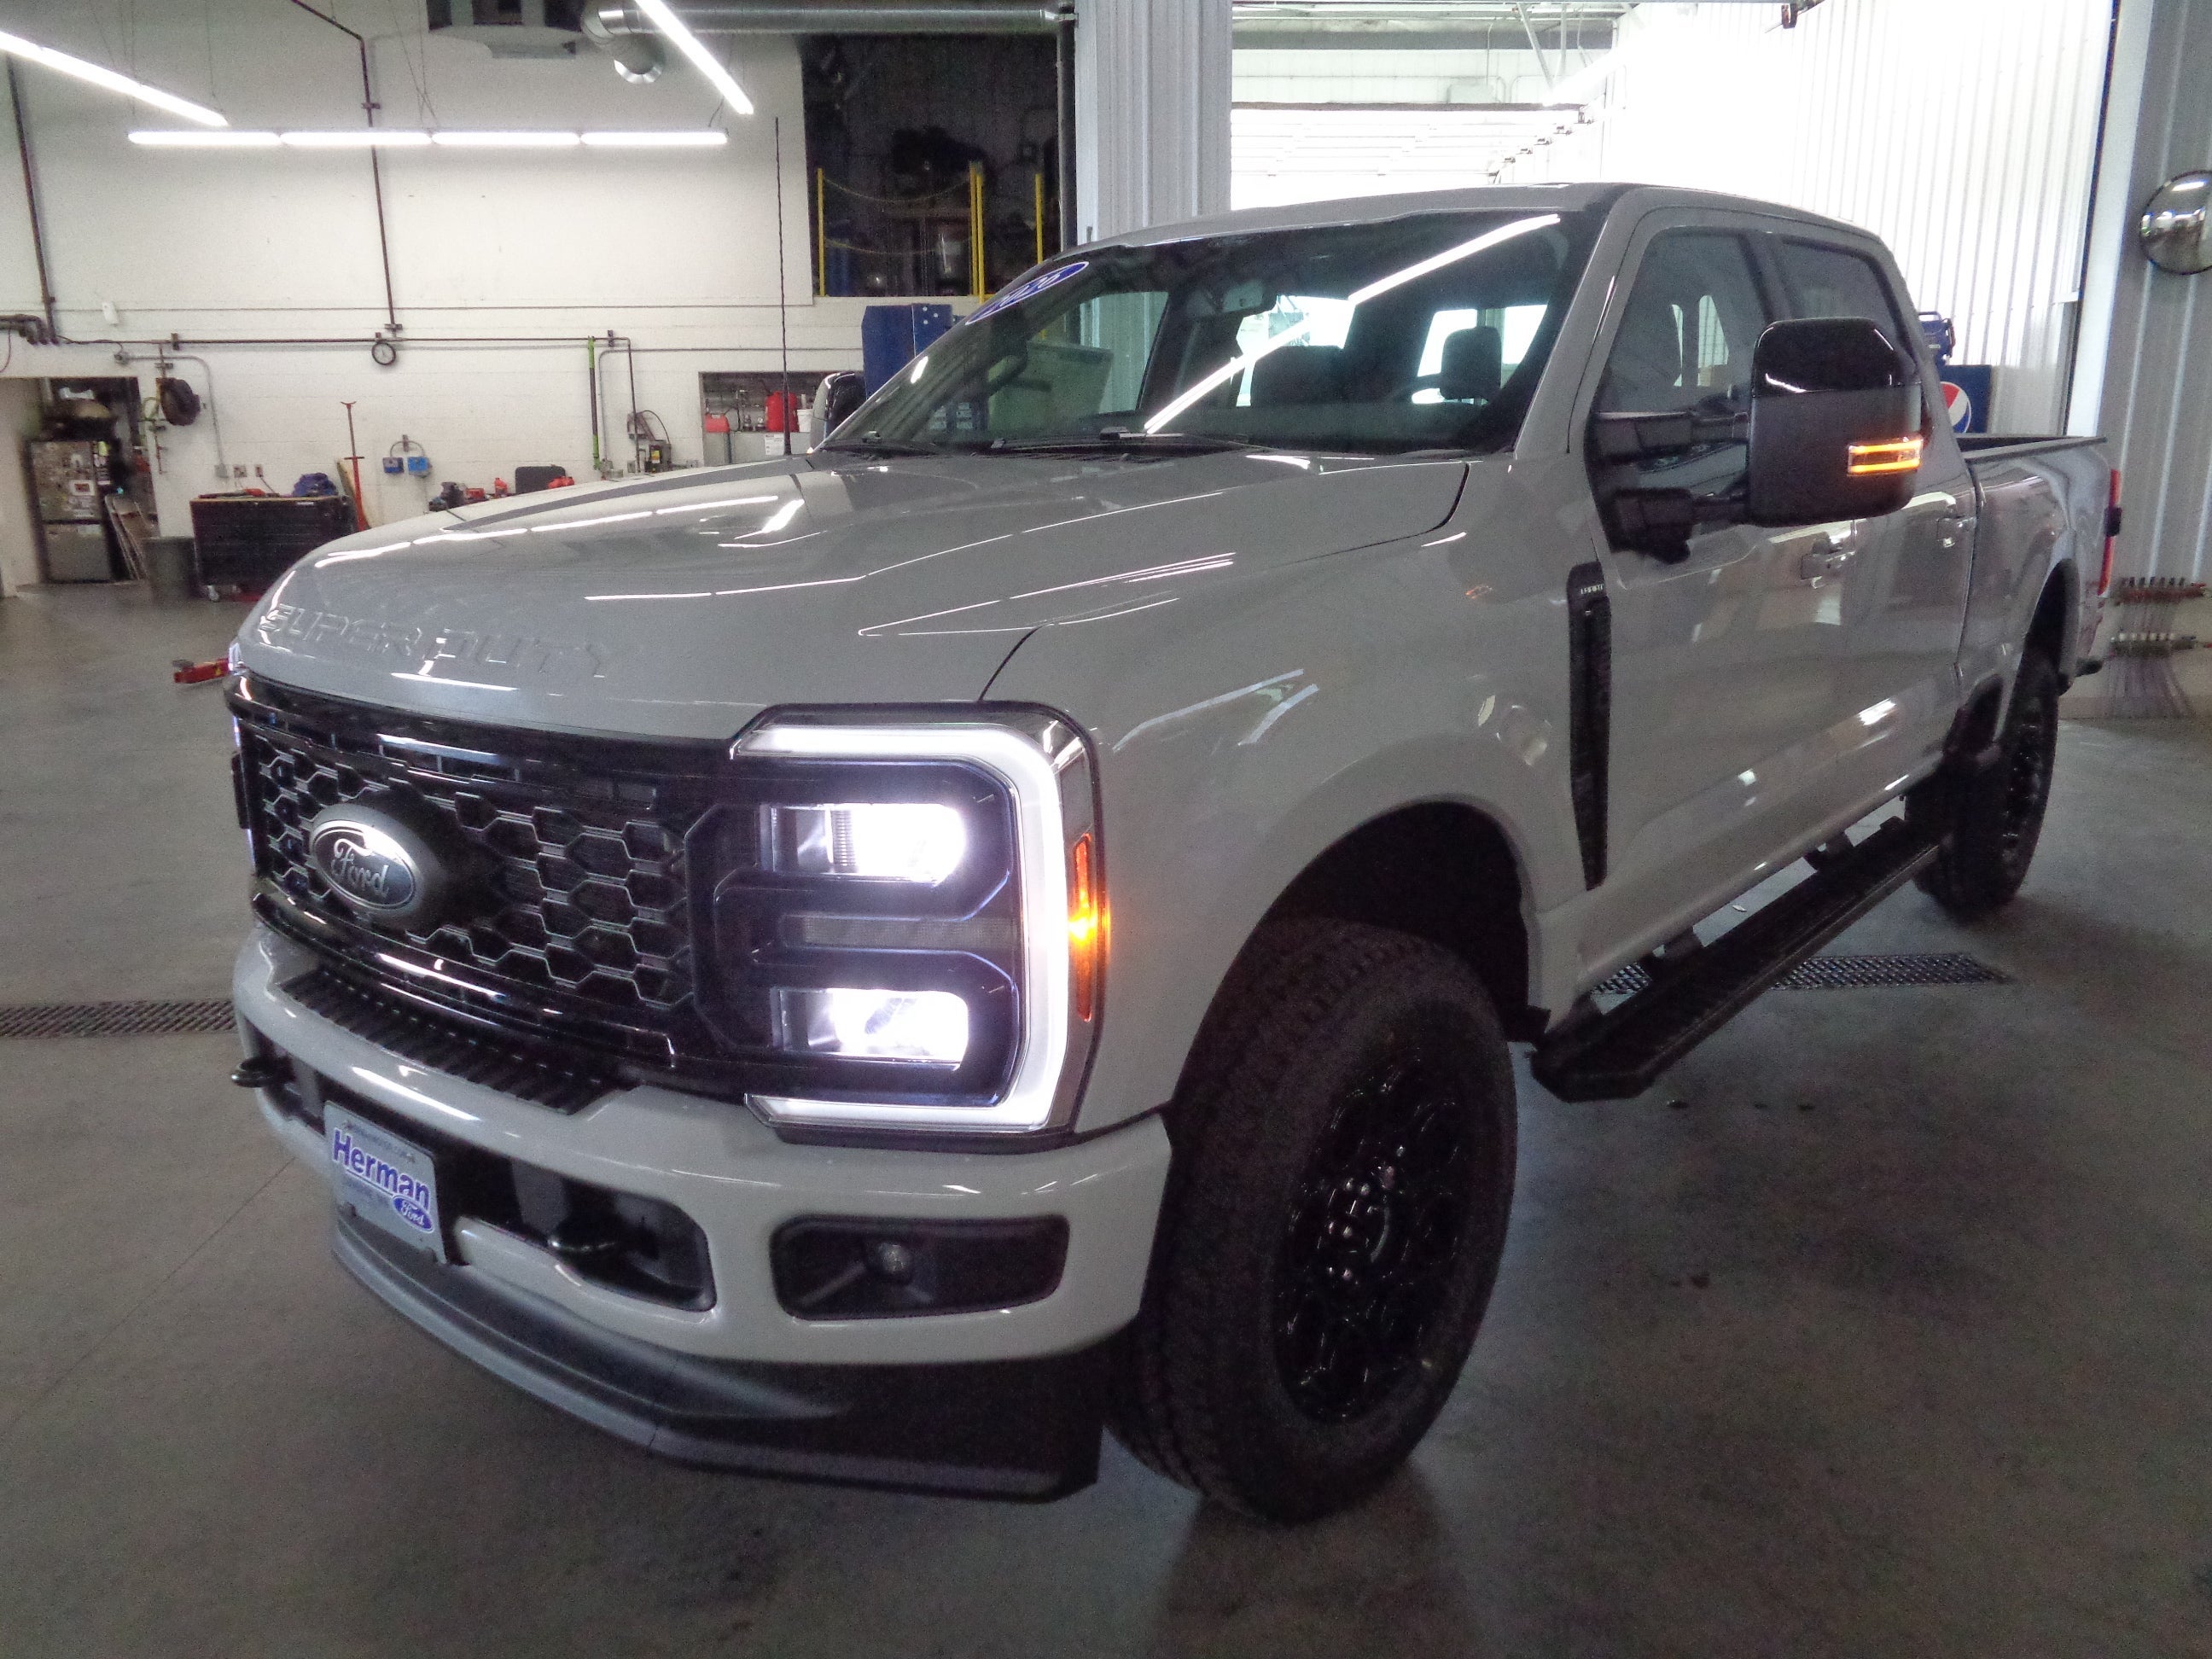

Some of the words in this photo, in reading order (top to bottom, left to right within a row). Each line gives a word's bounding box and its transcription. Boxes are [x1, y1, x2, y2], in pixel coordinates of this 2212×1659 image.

[258, 602, 422, 657] SUPER
[330, 837, 390, 897] Ford
[332, 1127, 431, 1212] Herman
[400, 1198, 425, 1226] Ford
